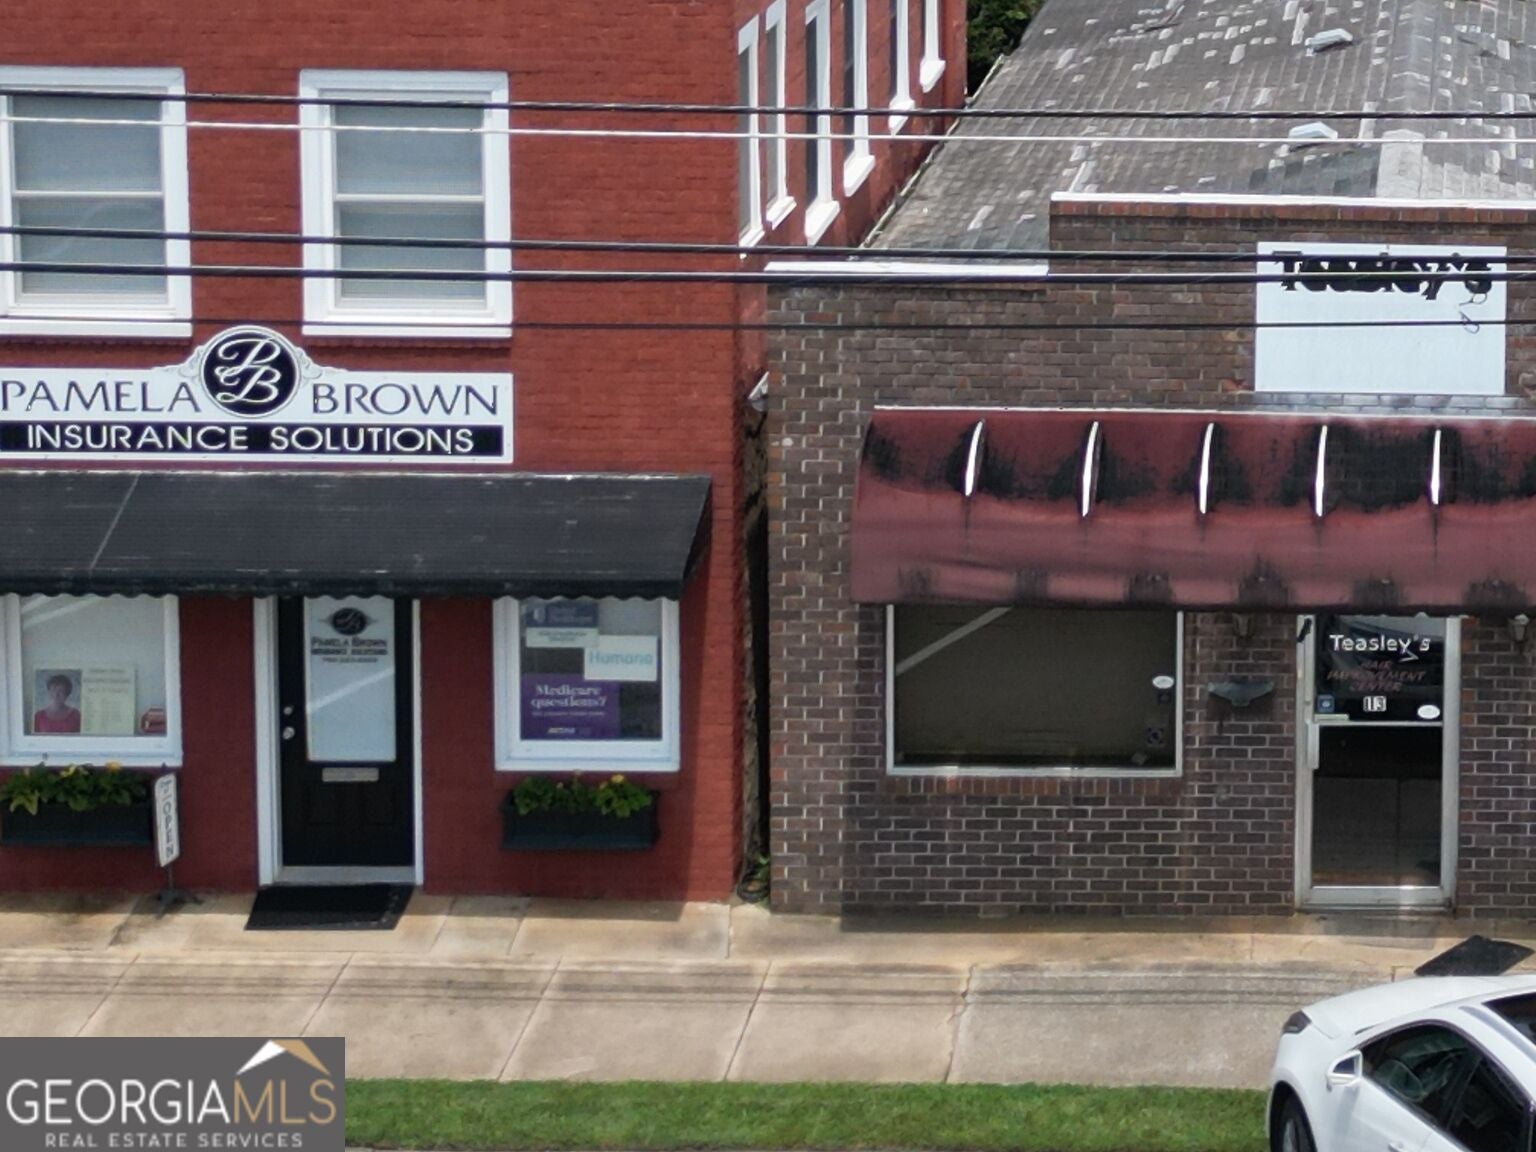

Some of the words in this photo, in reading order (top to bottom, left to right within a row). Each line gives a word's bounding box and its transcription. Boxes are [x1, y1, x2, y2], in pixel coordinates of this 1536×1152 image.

[1, 380, 202, 412] PAMELA
[312, 383, 499, 416] BROWN
[27, 423, 249, 451] INSURANCE
[270, 426, 475, 453] SOLUTIONS
[1329, 634, 1432, 661] Teasley's
[590, 651, 654, 665] Humana
[536, 684, 602, 696] Medicare
[530, 696, 607, 709] questions?
